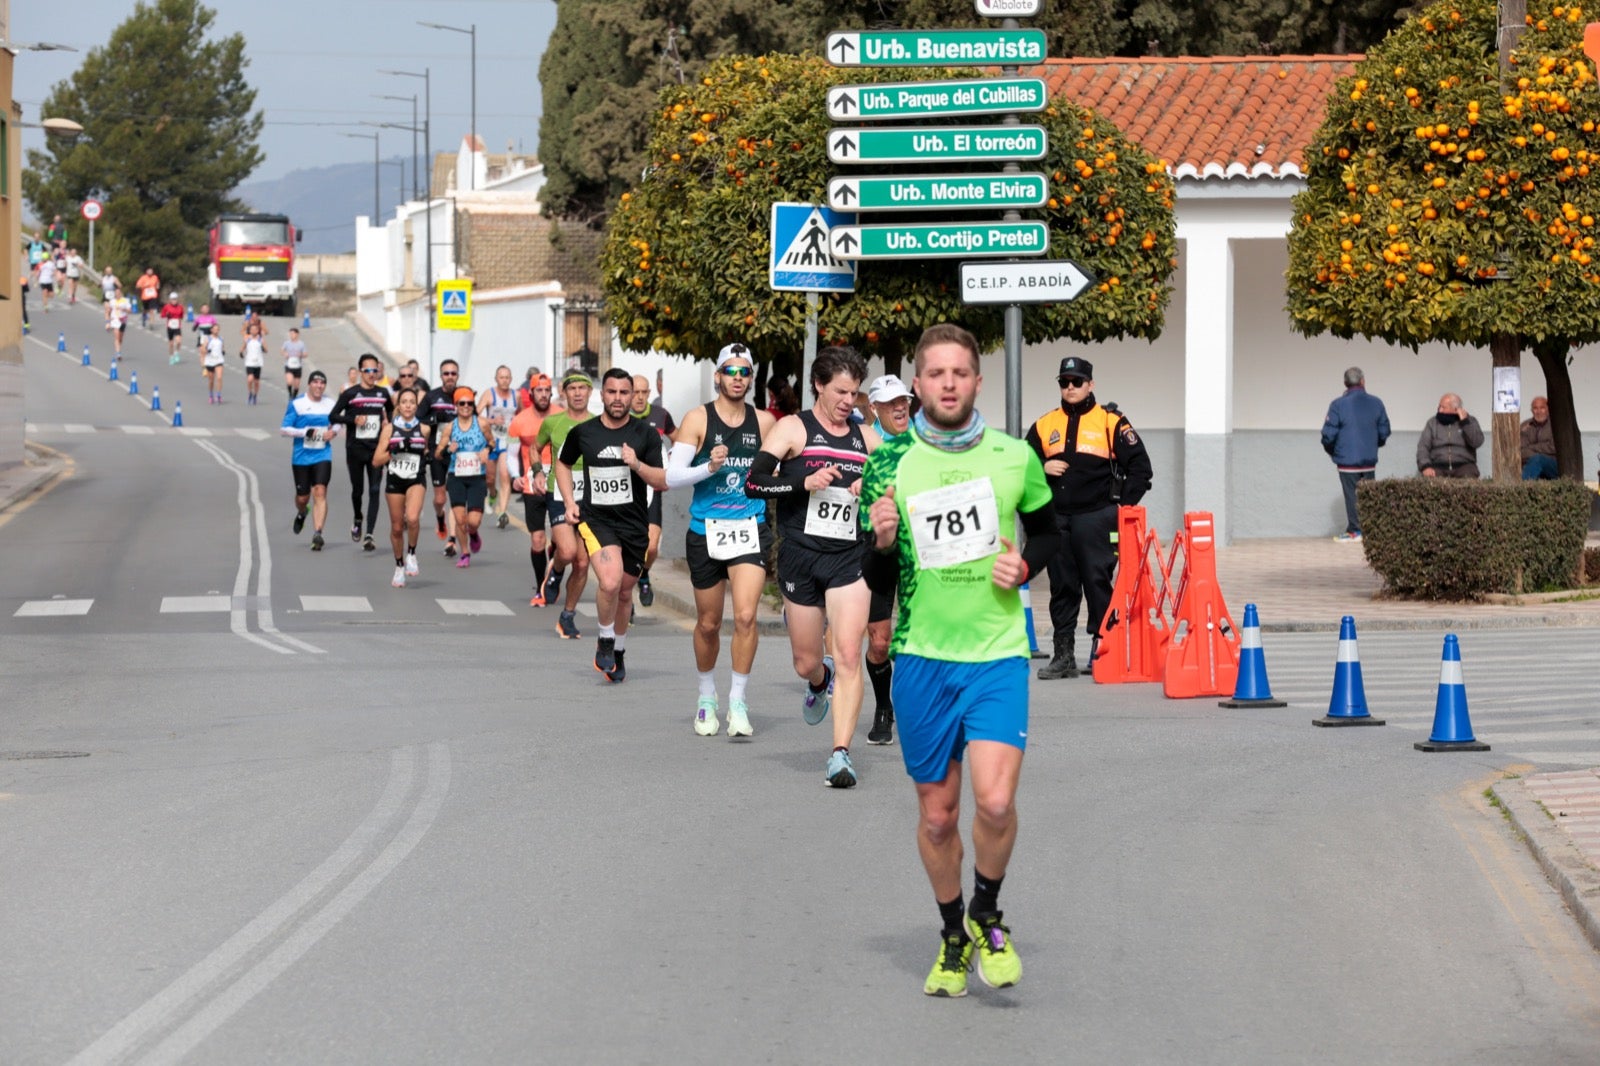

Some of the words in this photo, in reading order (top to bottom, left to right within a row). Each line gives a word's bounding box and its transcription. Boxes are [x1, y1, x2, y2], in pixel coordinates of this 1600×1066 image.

[866, 38, 911, 59] Urb.
[917, 37, 1041, 59] Buenavista
[864, 93, 894, 109] Urb.
[898, 91, 949, 110] Parque
[952, 88, 975, 105] del
[979, 86, 1037, 105] Cubillas
[912, 135, 948, 152] Urb.
[954, 135, 971, 151] El
[975, 133, 1037, 151] torreón
[890, 184, 926, 201] Urb.
[931, 183, 985, 200] Monte
[989, 182, 1036, 198] Elvira
[886, 232, 922, 249] Urb.
[927, 230, 983, 250] Cortijo
[988, 229, 1038, 246] Pretel
[966, 277, 1012, 289] C.E.I.P.
[1018, 272, 1072, 288] ABADÍA
[593, 478, 630, 494] 3095
[817, 501, 852, 523] 876
[926, 504, 982, 541] 781
[716, 529, 751, 547] 215
